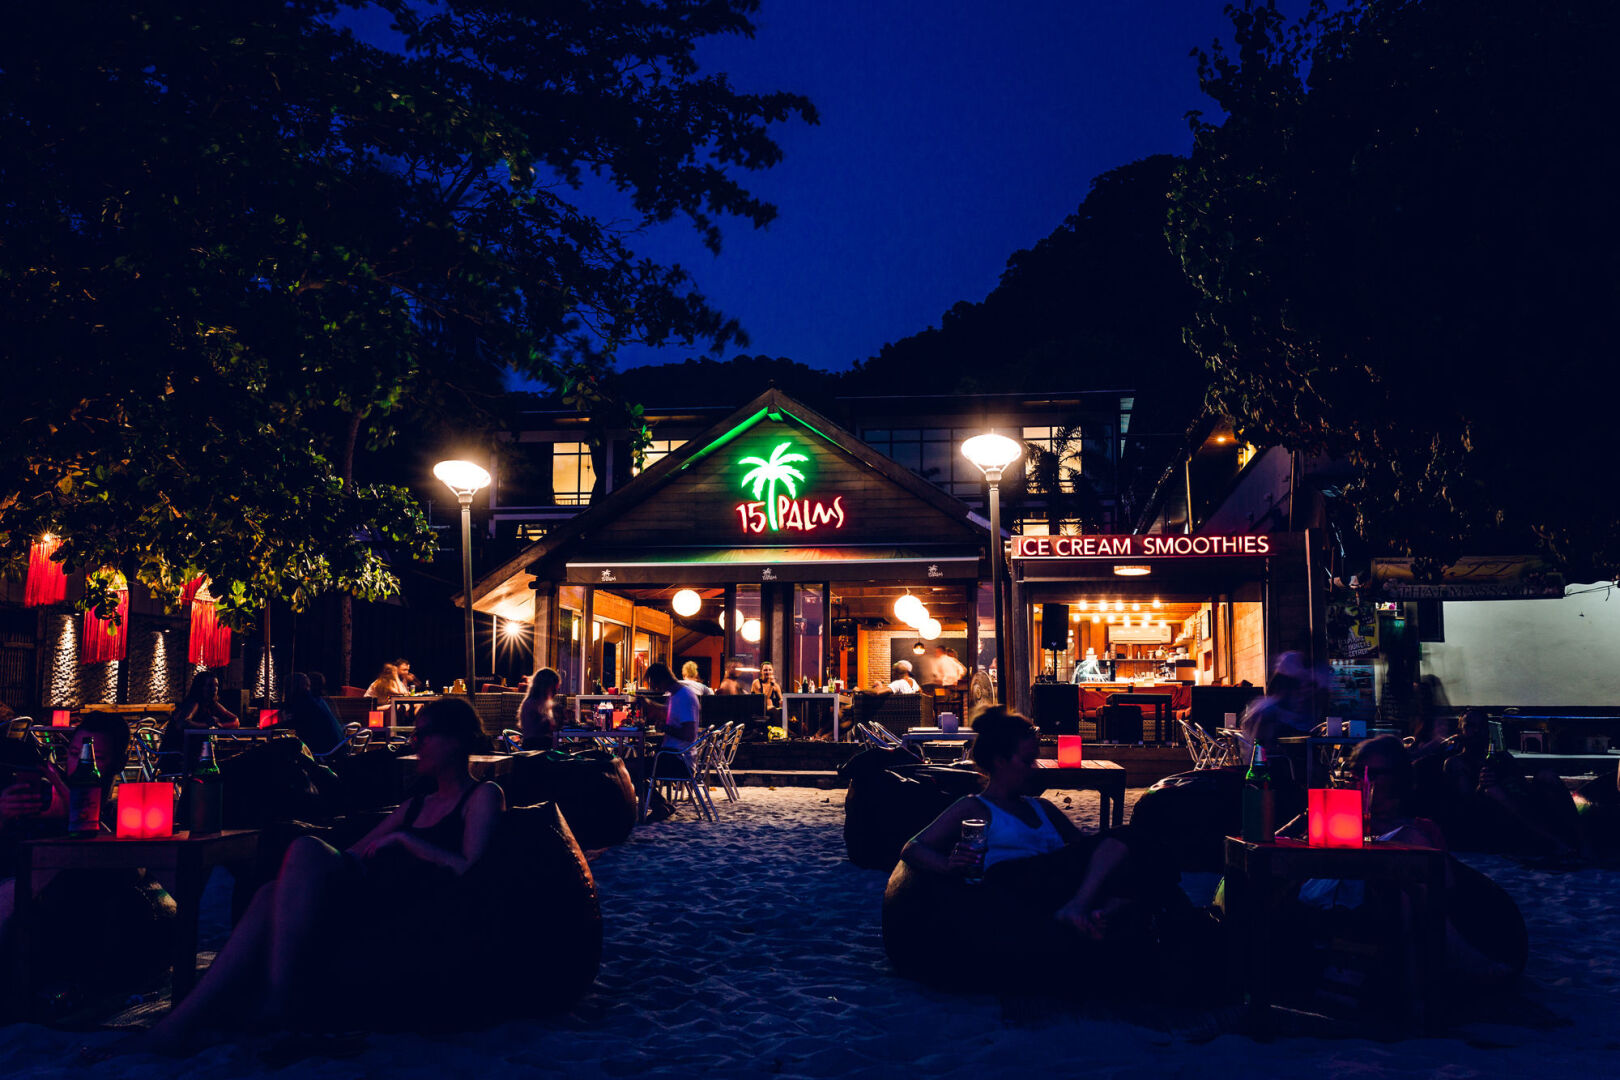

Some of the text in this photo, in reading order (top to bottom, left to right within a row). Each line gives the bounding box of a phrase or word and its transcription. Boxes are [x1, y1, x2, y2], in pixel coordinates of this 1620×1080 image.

[736, 495, 844, 533] 15 PALMS
[1018, 535, 1269, 556] ICE CREAM SMOOTHIES
[1399, 586, 1442, 598] THAI
